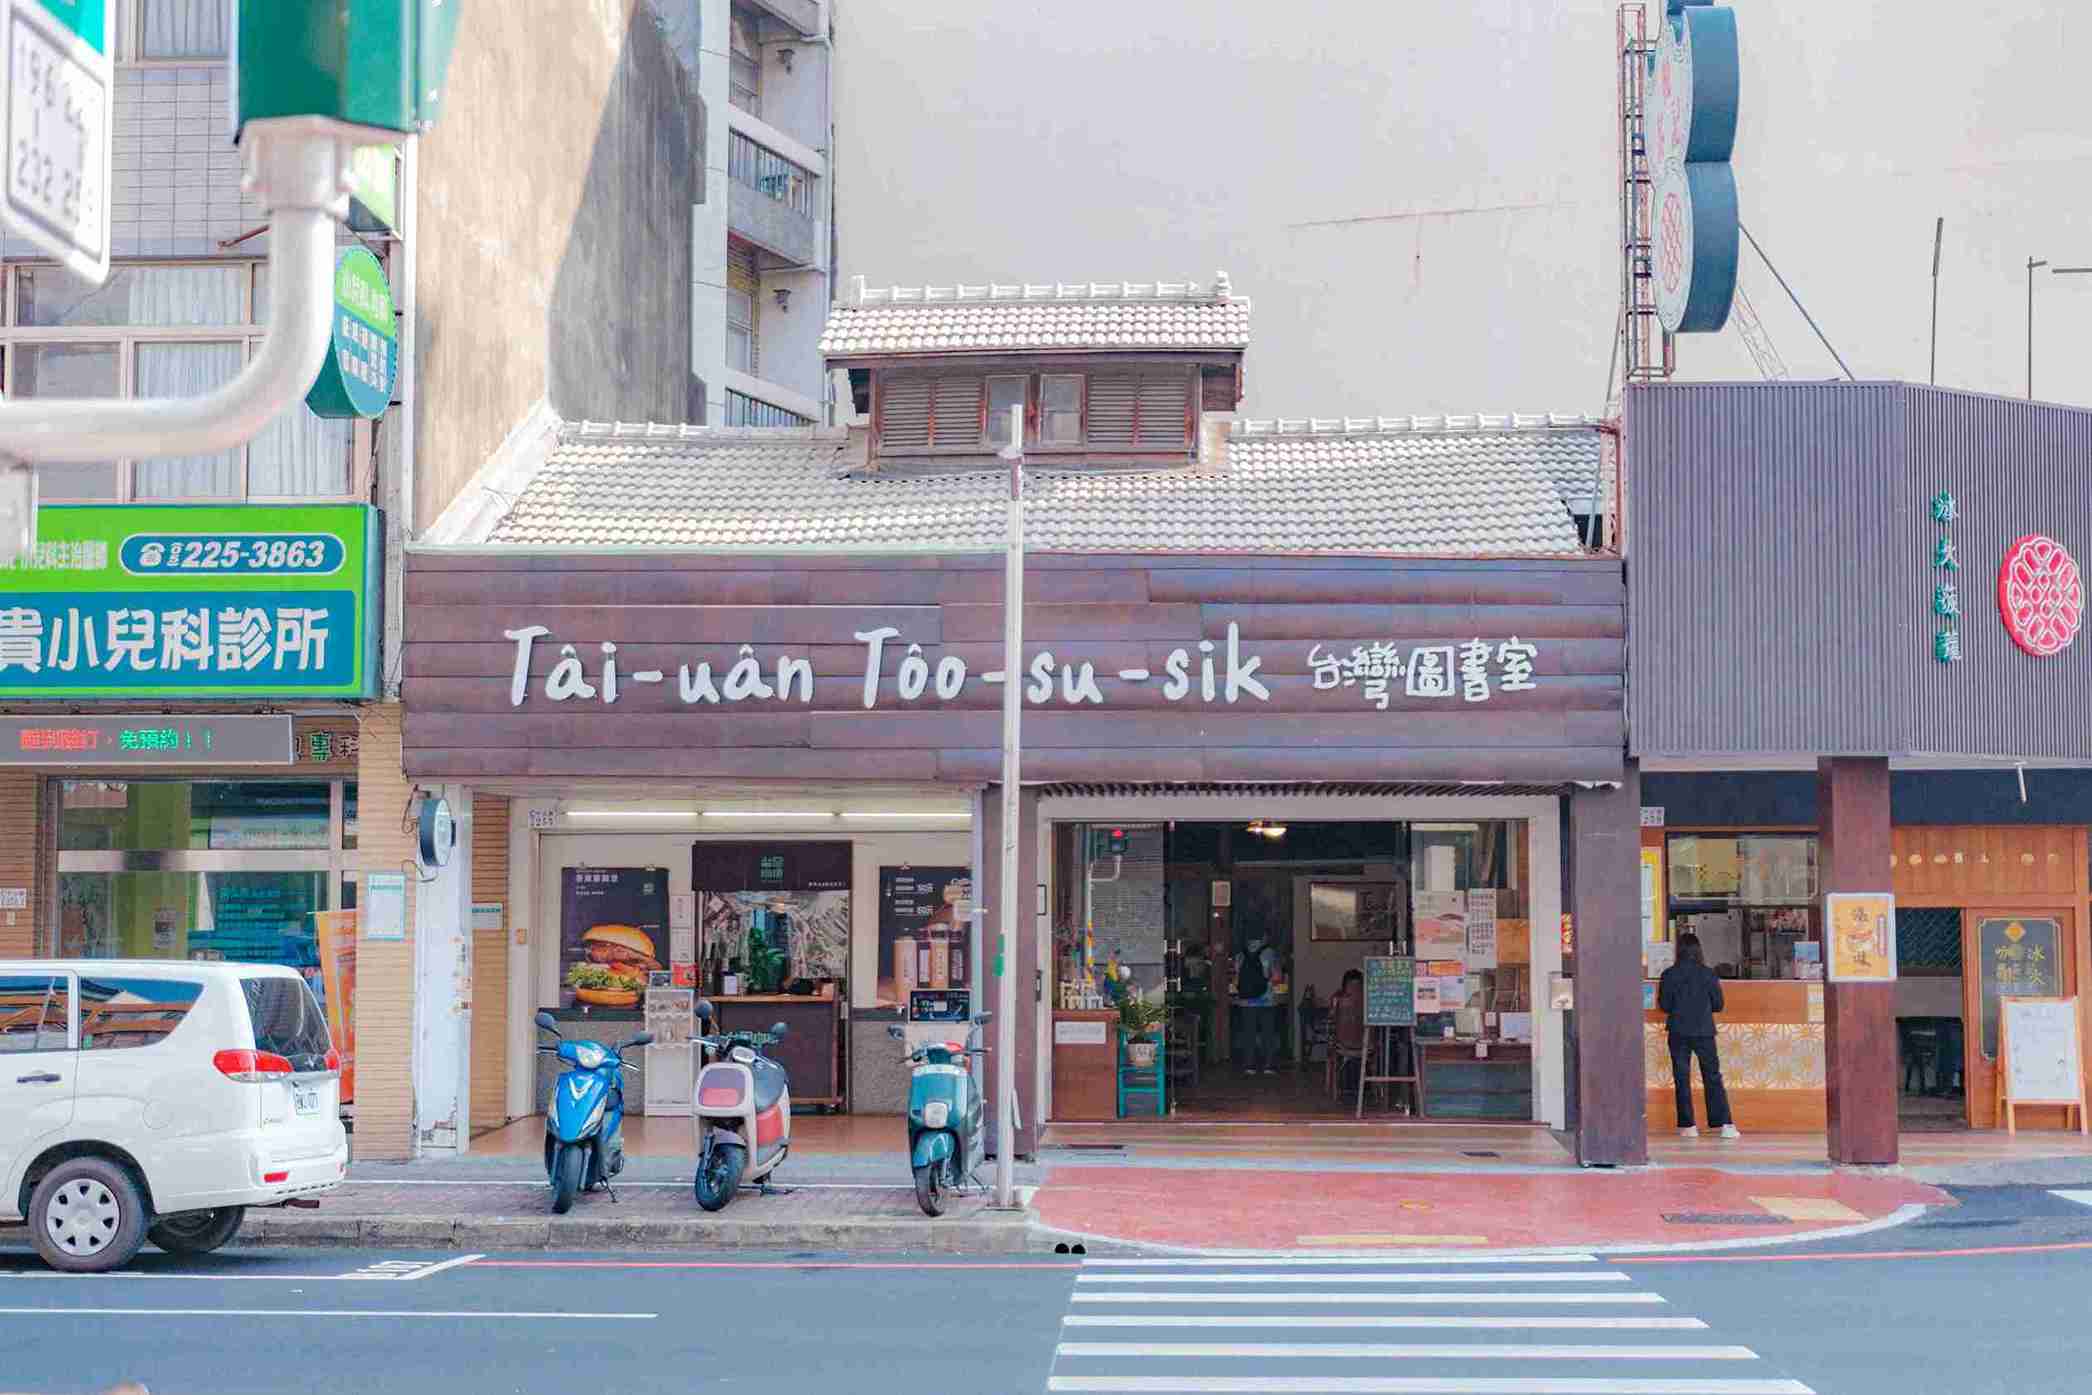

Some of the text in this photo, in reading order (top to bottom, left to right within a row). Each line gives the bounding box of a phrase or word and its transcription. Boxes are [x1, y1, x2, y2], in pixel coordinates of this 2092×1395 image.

[504, 625, 814, 706] Tâi-uân
[1307, 634, 1538, 710] 台灣圖書室
